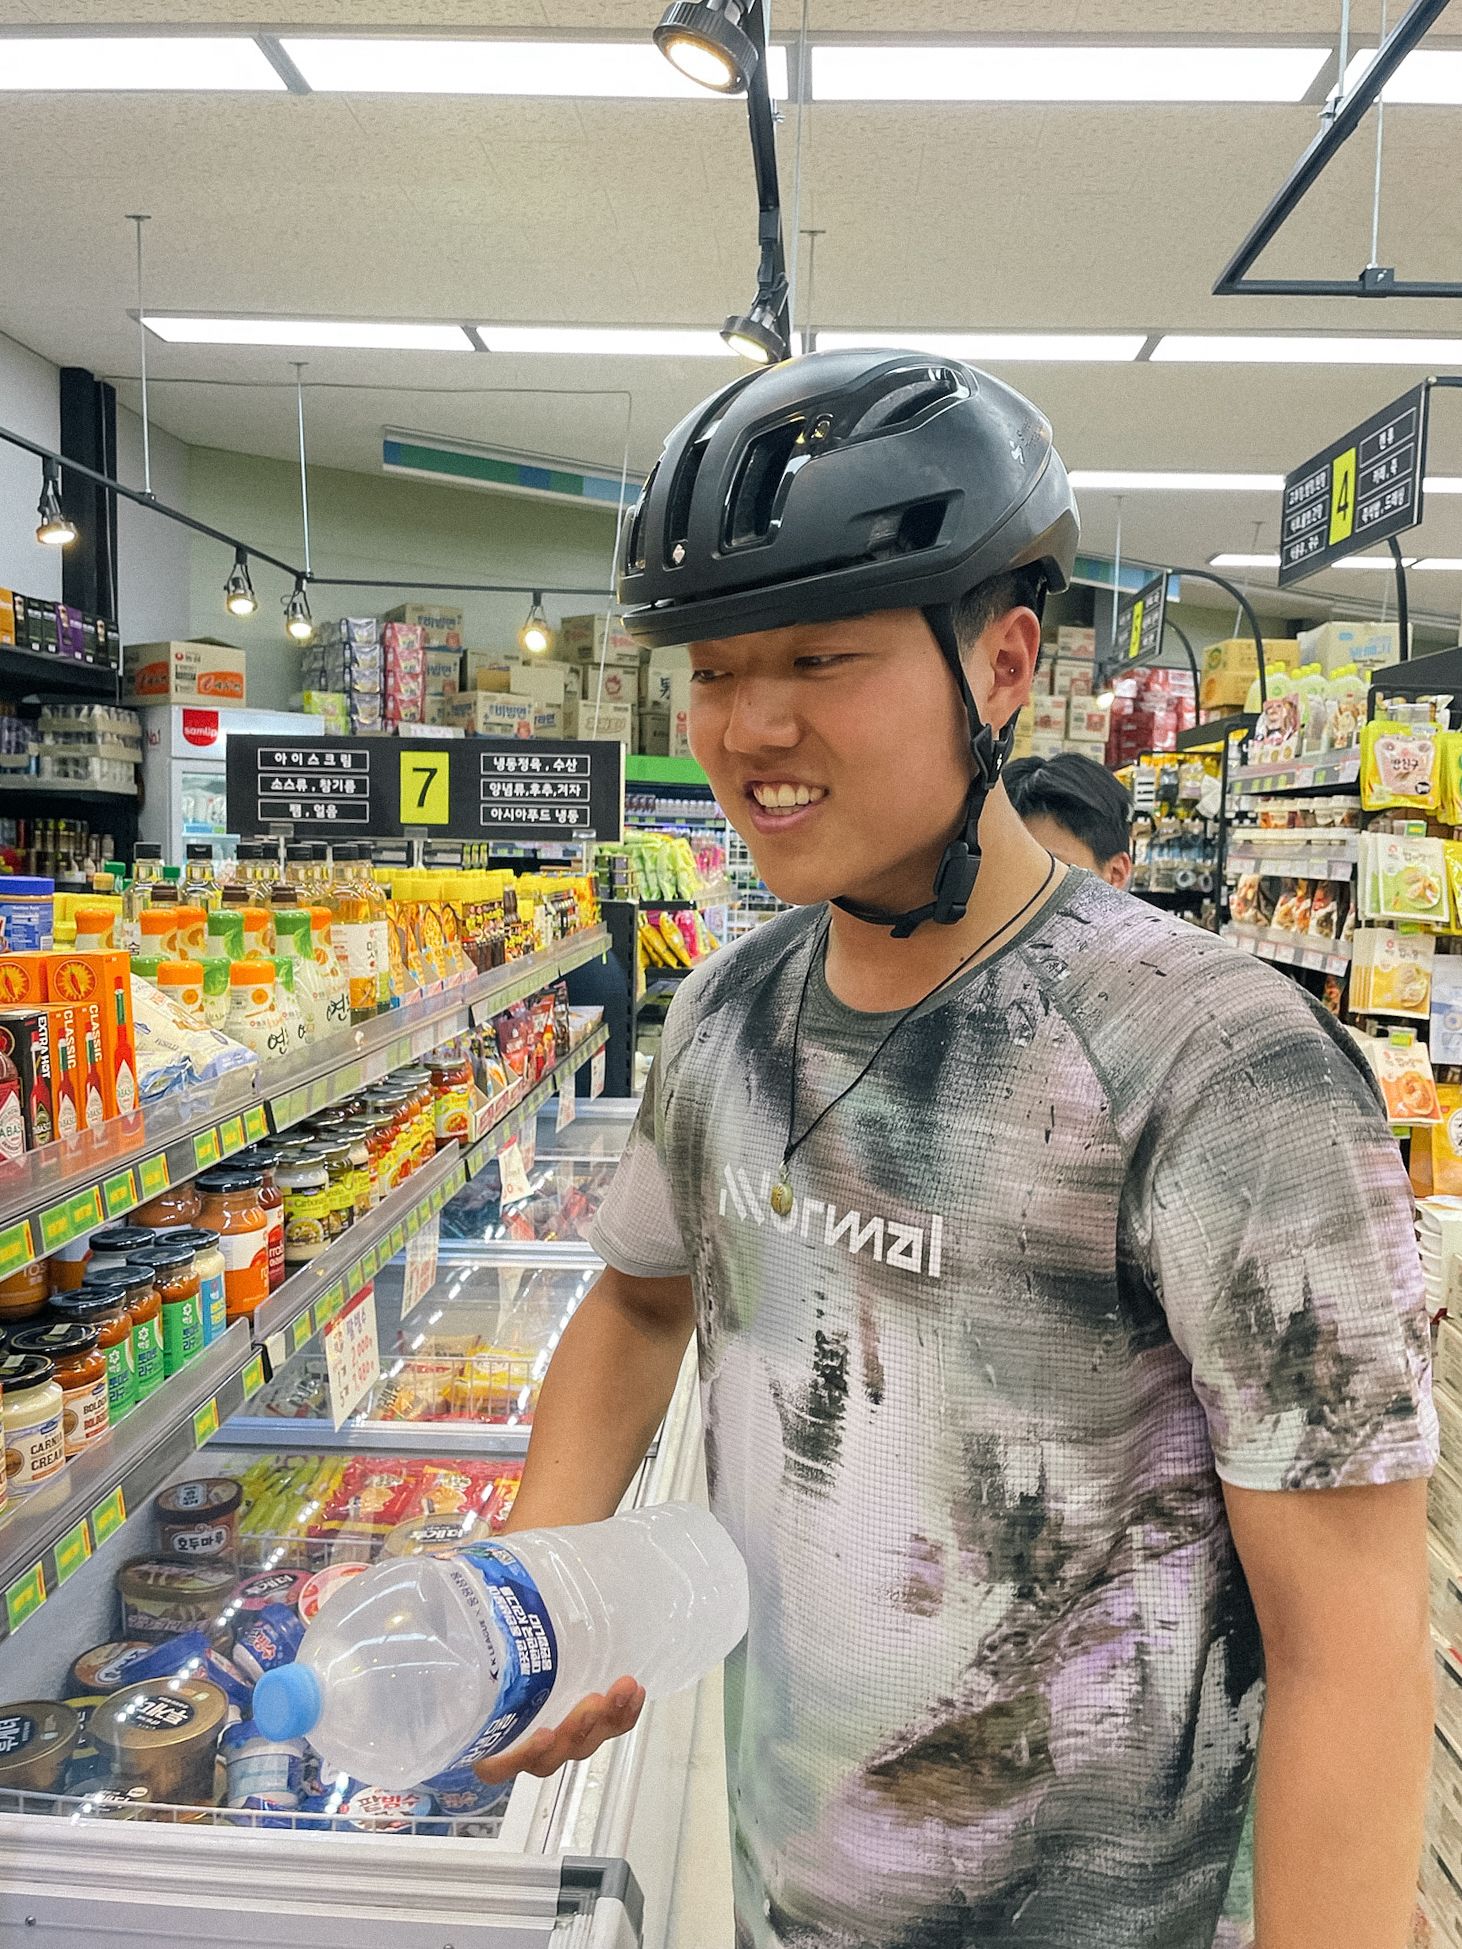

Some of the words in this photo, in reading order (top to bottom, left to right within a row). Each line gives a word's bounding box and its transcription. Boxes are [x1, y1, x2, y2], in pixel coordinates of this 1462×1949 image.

[1337, 470, 1349, 521] 4
[184, 726, 218, 738] samlip
[552, 758, 578, 773] 수산
[319, 778, 356, 794] 참기름
[411, 767, 438, 808] 7
[313, 803, 338, 819] 얼음
[490, 807, 551, 822] 아시아푸드
[555, 808, 579, 824] 냉동
[37, 1015, 49, 1056] EXTRA
[63, 1009, 76, 1069] CLASSIC
[89, 1003, 102, 1063] CLASSIC
[42, 1056, 50, 1079] HOT
[178, 1531, 223, 1550] 호두마루
[479, 1619, 495, 1657] LEAGUE
[514, 1638, 531, 1676] 깨끗한
[520, 1626, 541, 1674] 대한민국
[527, 1613, 553, 1671] 응원합니다
